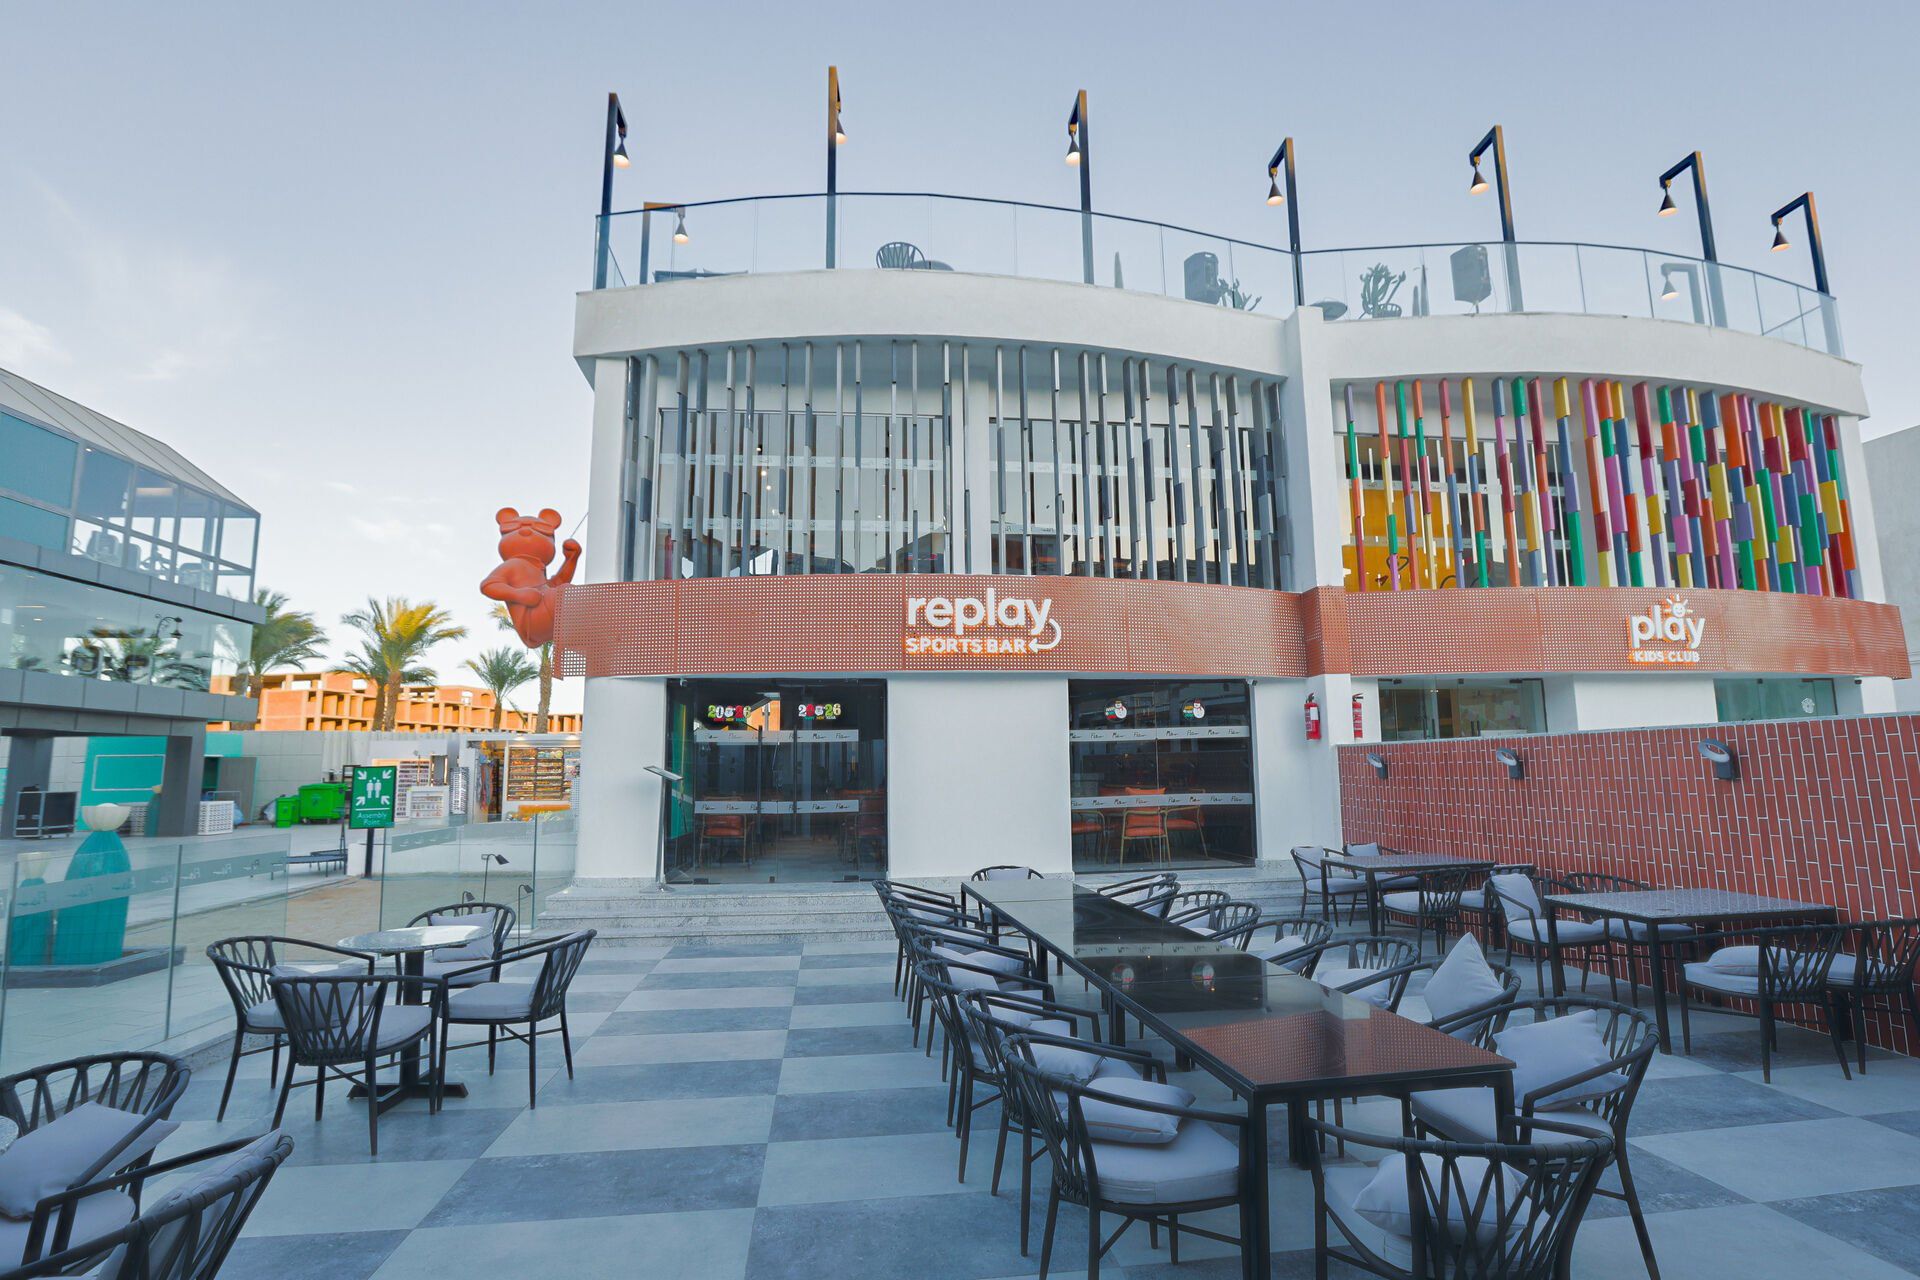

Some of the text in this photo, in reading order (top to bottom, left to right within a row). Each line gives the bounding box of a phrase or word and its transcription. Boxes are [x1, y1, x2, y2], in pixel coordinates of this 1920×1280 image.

[907, 587, 1052, 636] replay
[1631, 604, 1706, 649] play
[905, 637, 1028, 654] SPORTS BAR
[1634, 650, 1700, 663] KIDS CLUB
[357, 811, 387, 819] Assembly
[363, 819, 380, 827] Point
